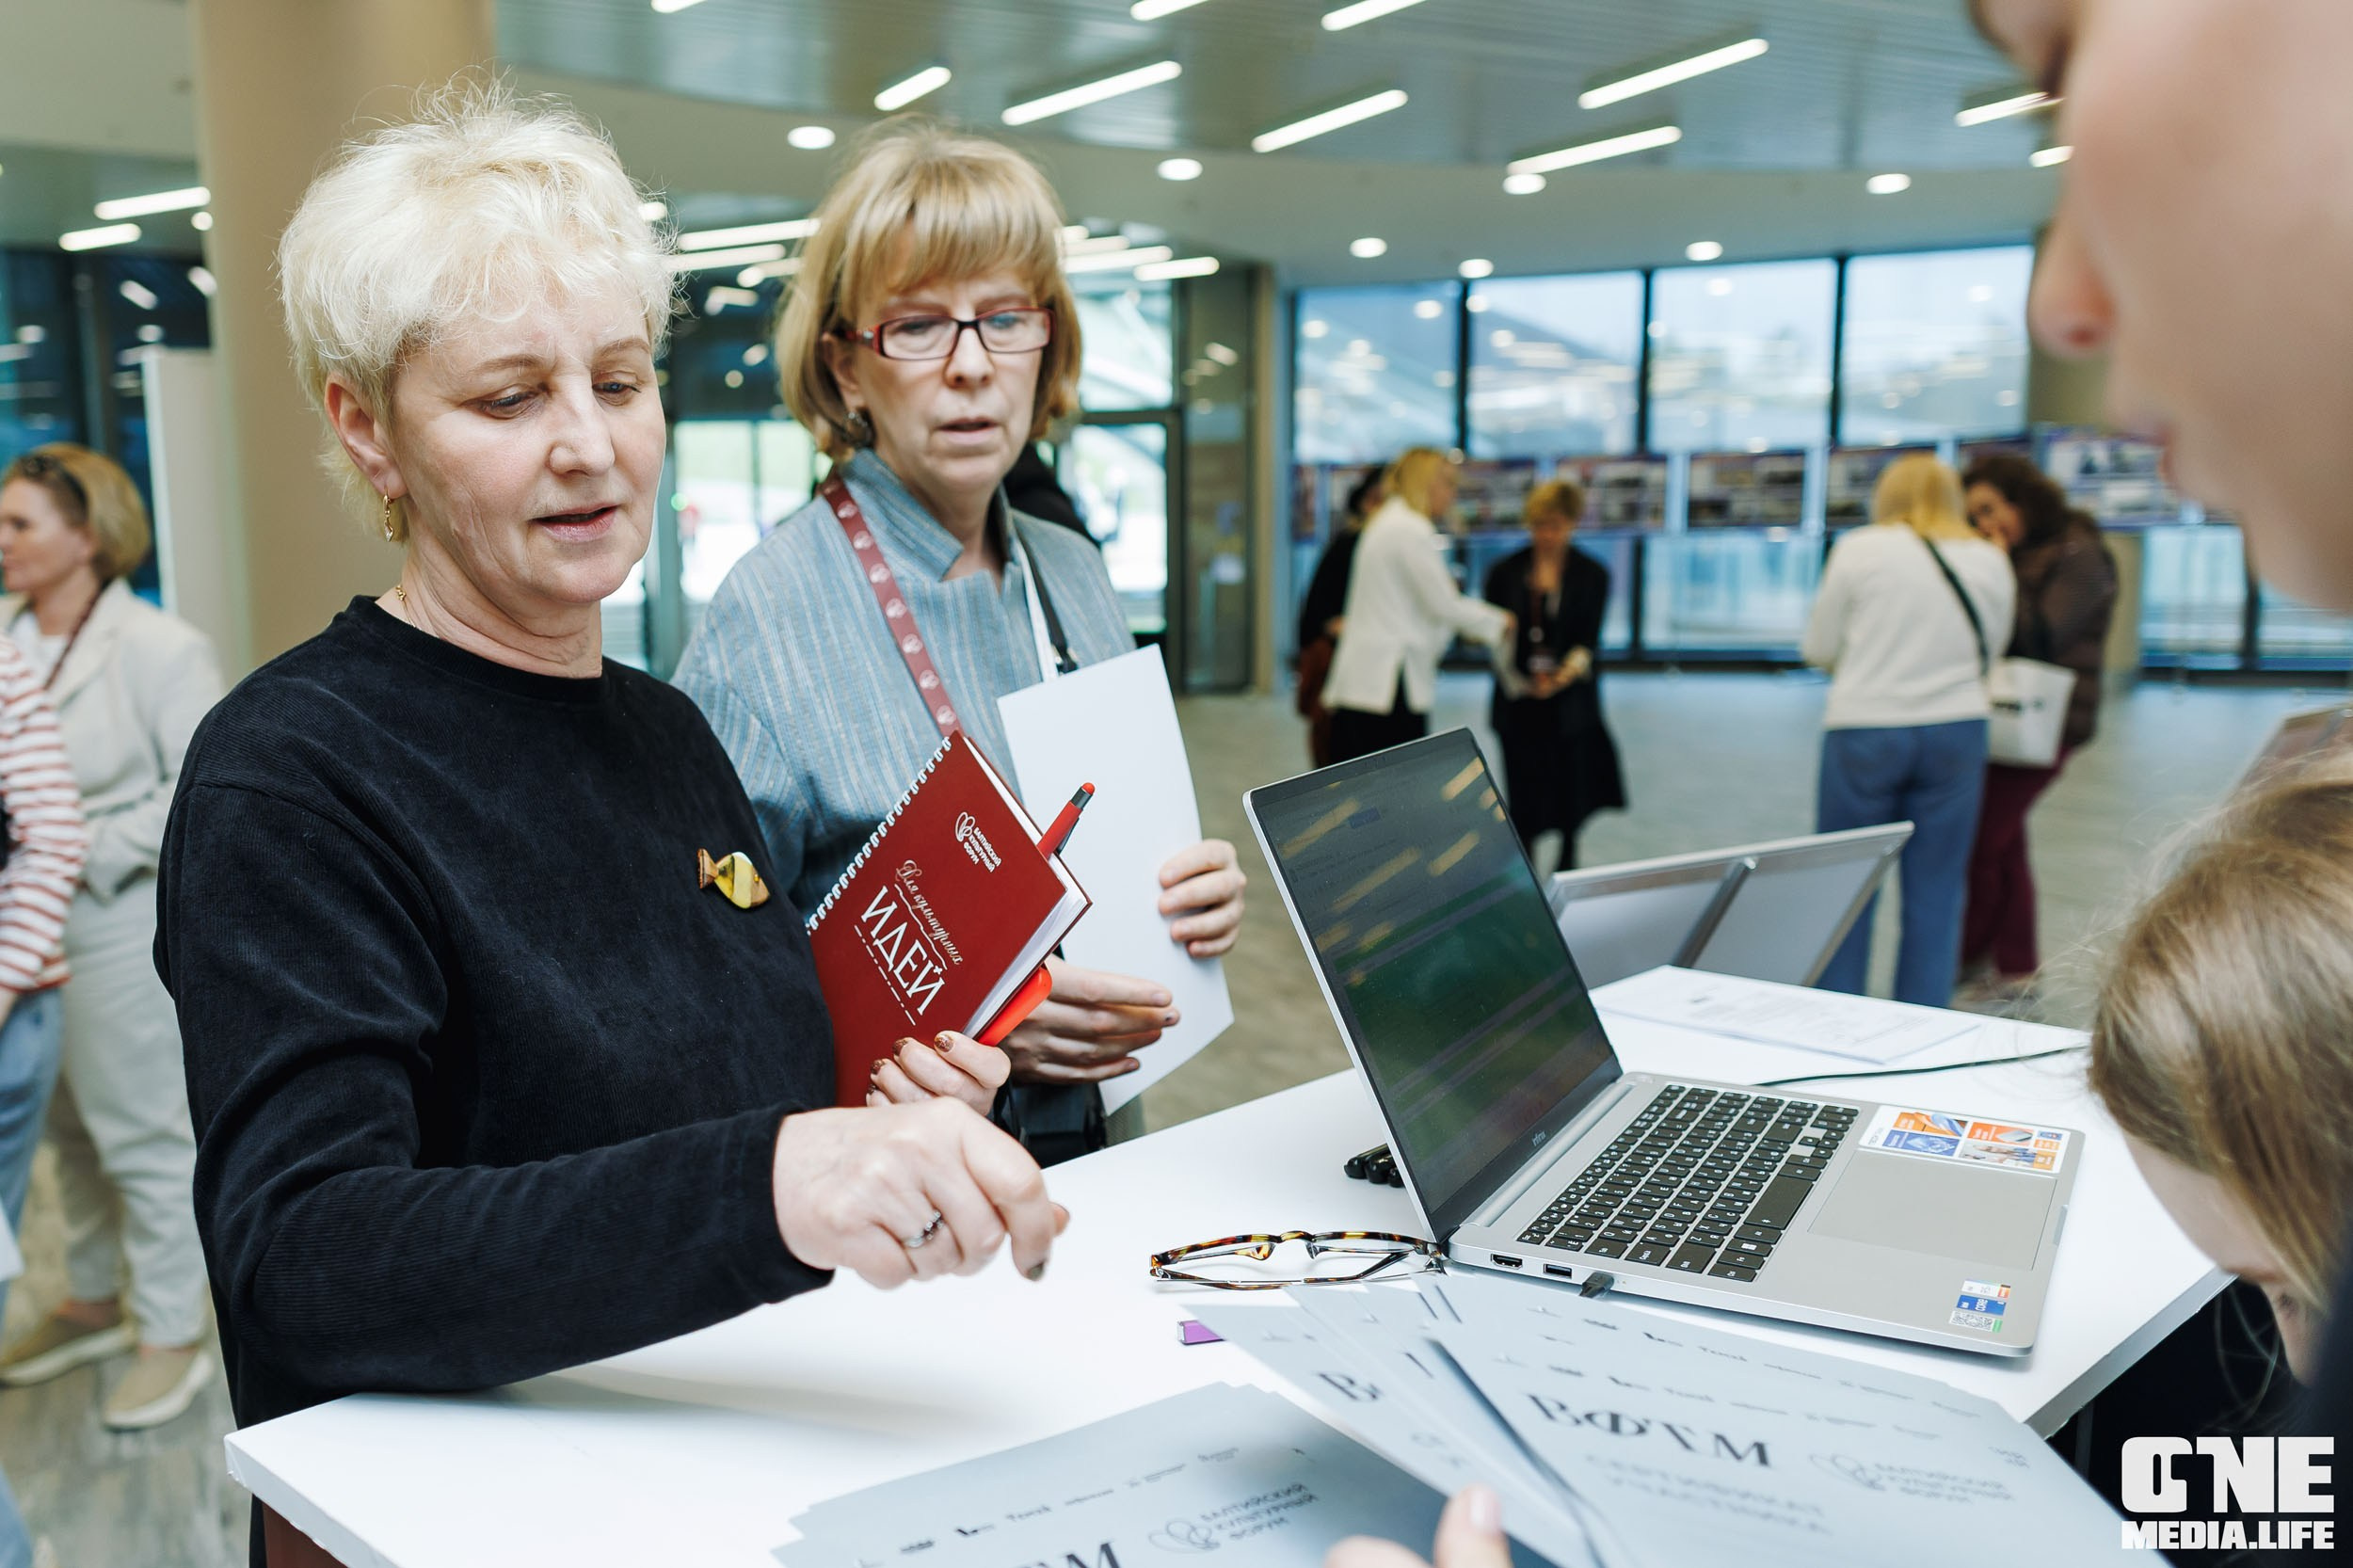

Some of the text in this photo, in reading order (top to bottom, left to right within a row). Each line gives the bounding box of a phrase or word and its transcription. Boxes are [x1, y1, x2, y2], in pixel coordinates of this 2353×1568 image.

[860, 886, 947, 1016] ИДЕЙ
[895, 859, 964, 966] Для культурных
